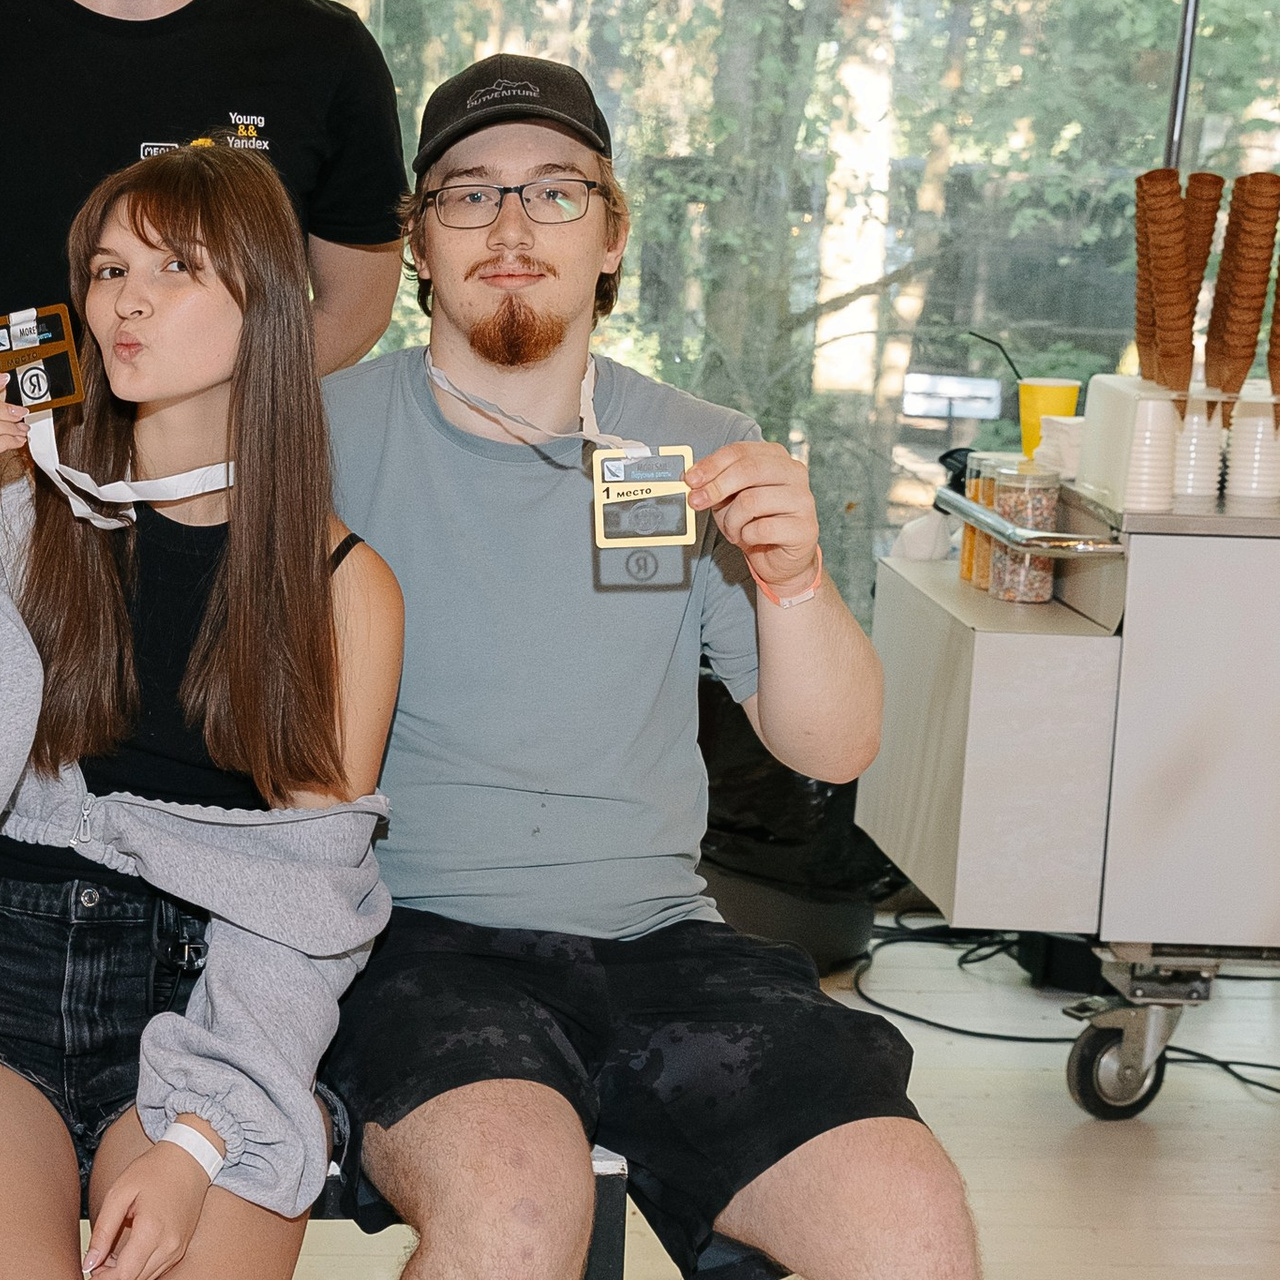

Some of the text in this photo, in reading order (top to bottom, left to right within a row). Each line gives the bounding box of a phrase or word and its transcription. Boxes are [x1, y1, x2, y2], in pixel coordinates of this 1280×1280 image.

[466, 89, 540, 109] OUTVENTURE
[228, 112, 265, 127] Young
[226, 136, 270, 151] Yandex
[6, 351, 38, 367] место
[602, 486, 652, 500] 1 место
